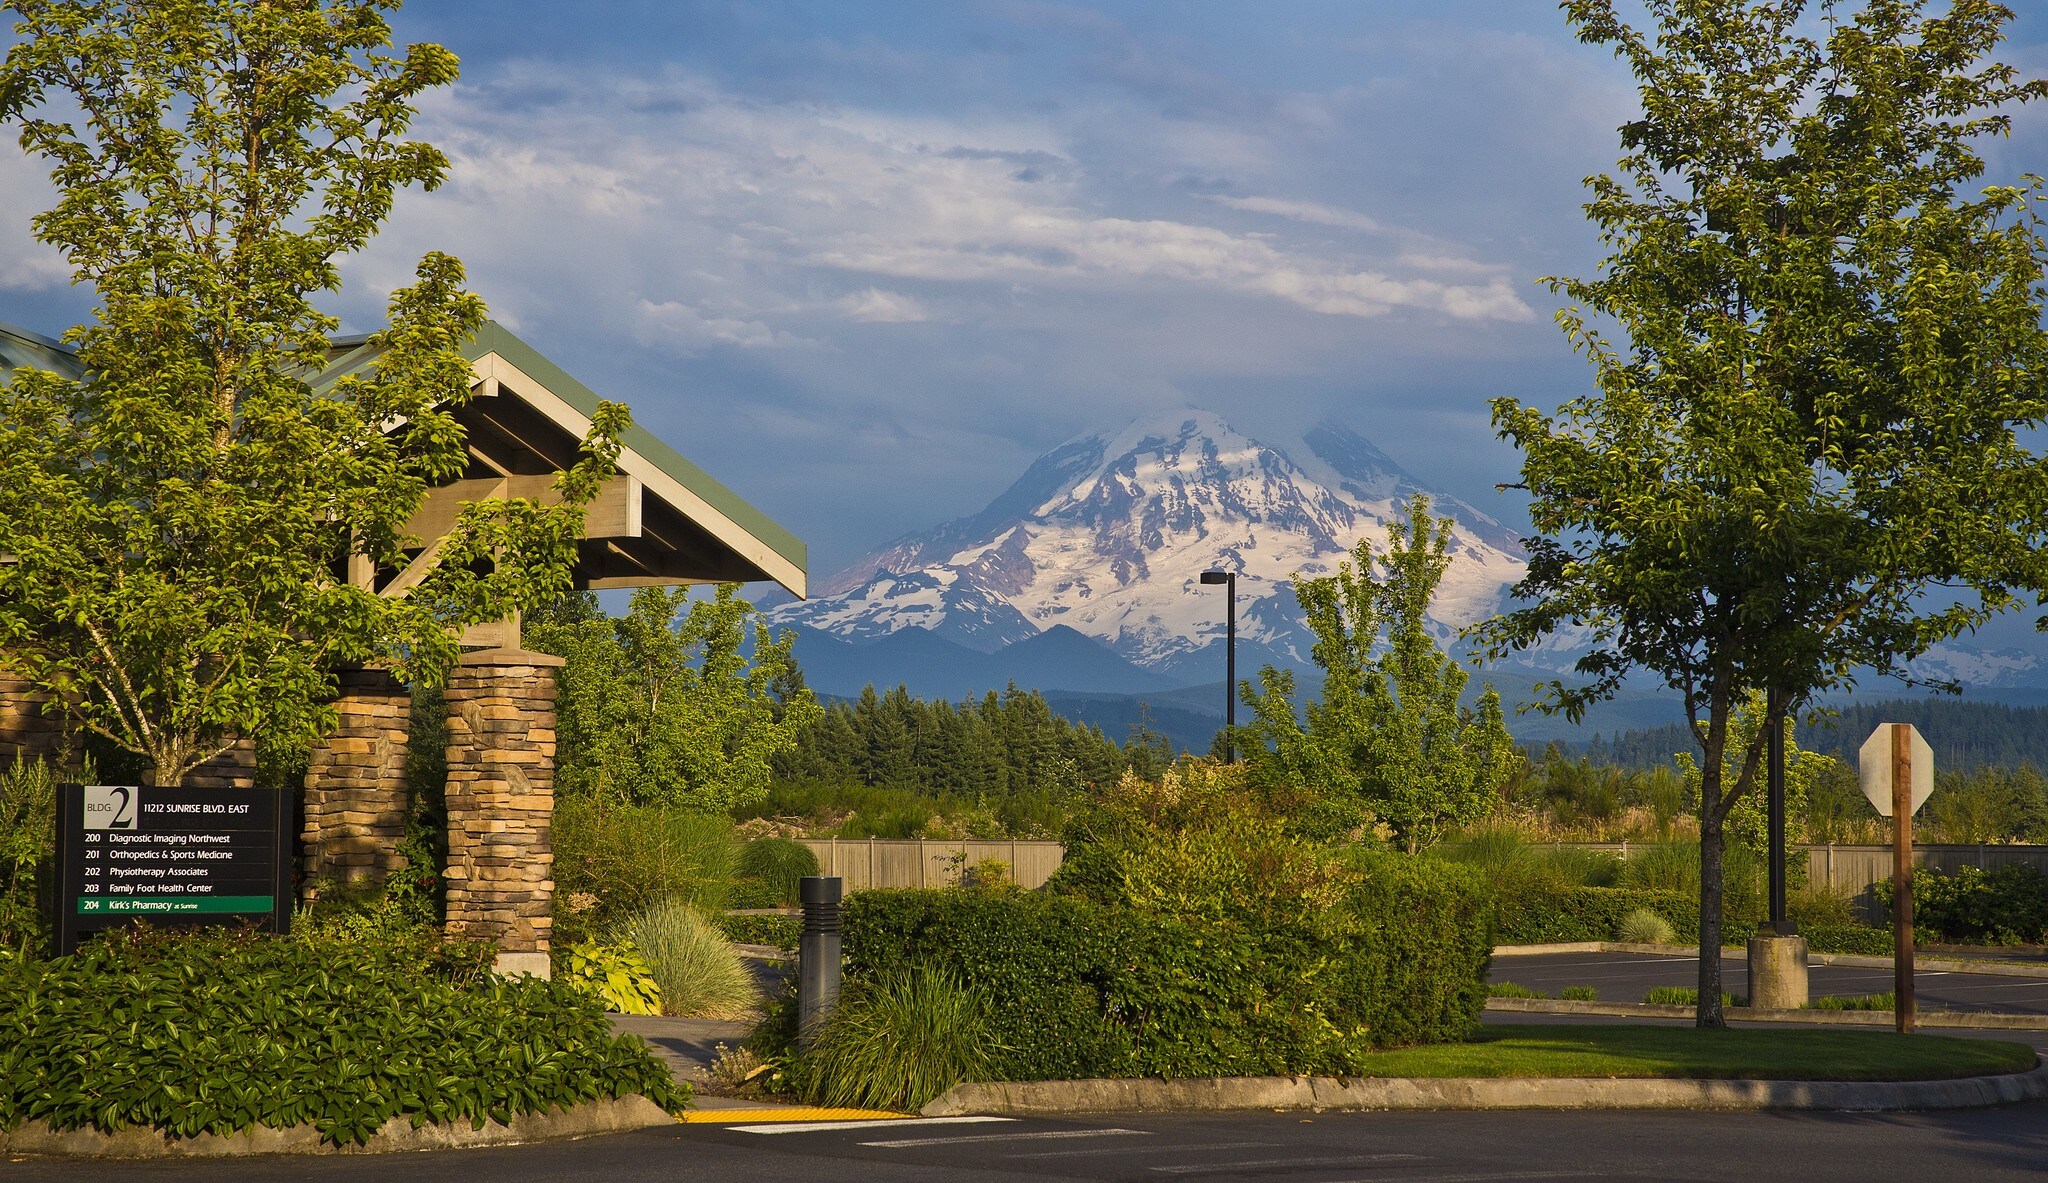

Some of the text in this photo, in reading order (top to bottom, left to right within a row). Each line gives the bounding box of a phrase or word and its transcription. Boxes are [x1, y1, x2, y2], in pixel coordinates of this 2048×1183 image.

[109, 787, 132, 828] 2
[144, 804, 249, 813] 11212 SUNRISE BLVD. EAST
[85, 834, 230, 845] 200 Diagnostic Imaging Northwest
[86, 850, 233, 860] 201 Orthopedics & Sports Medicine
[85, 868, 208, 878] 202 Physiotherapy Associates
[85, 884, 212, 894] 203 Family Foot Health Center
[84, 901, 99, 909] 204
[109, 901, 129, 909] Kirk's
[132, 901, 172, 911] Pharmacy
